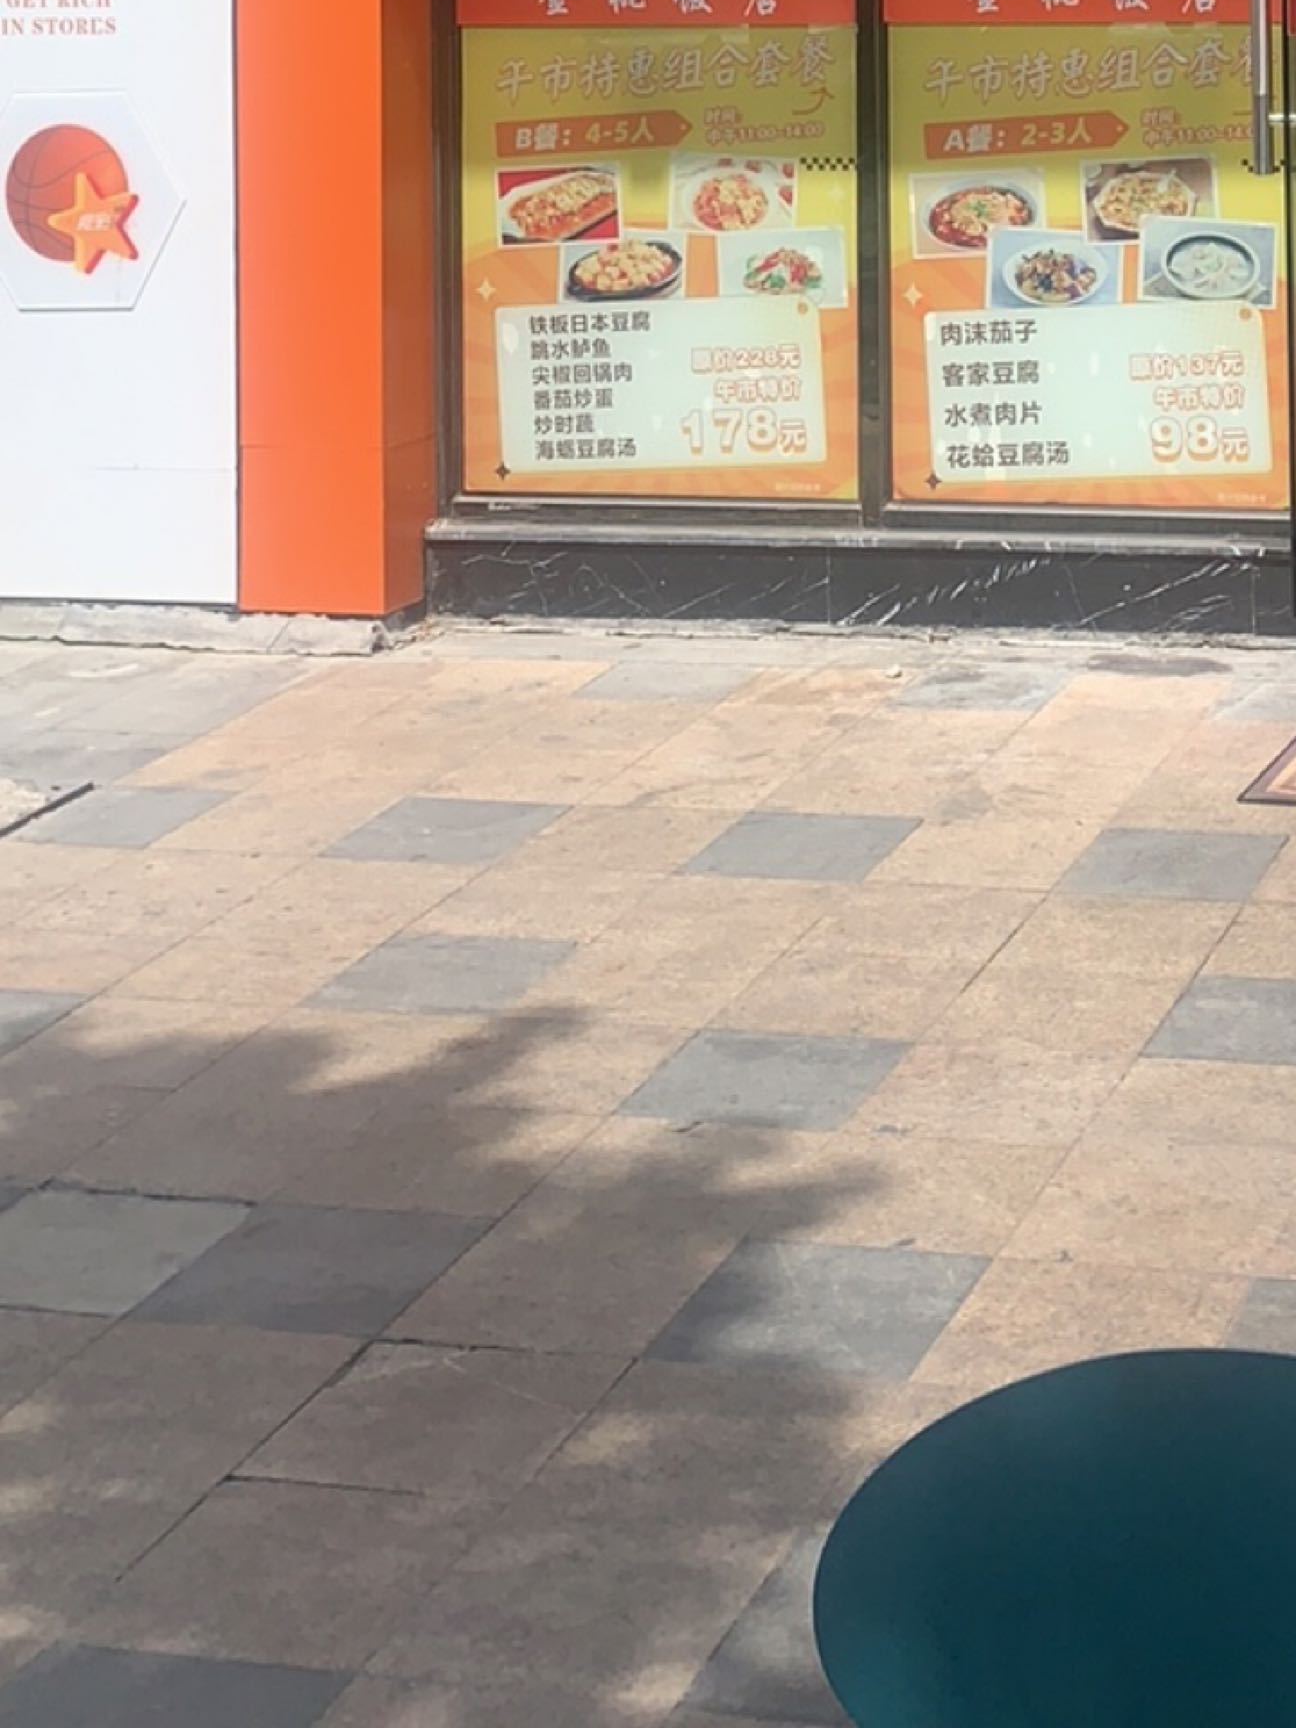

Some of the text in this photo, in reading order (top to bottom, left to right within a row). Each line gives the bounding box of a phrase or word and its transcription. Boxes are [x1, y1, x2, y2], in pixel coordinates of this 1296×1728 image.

[1, 17, 117, 35] IN STORES
[497, 35, 835, 104] 午市特惠组合套餐
[530, 311, 650, 335] 铁板日本豆腐
[942, 360, 1040, 387] 客家豆腐
[944, 401, 1042, 427] 水煮肉片
